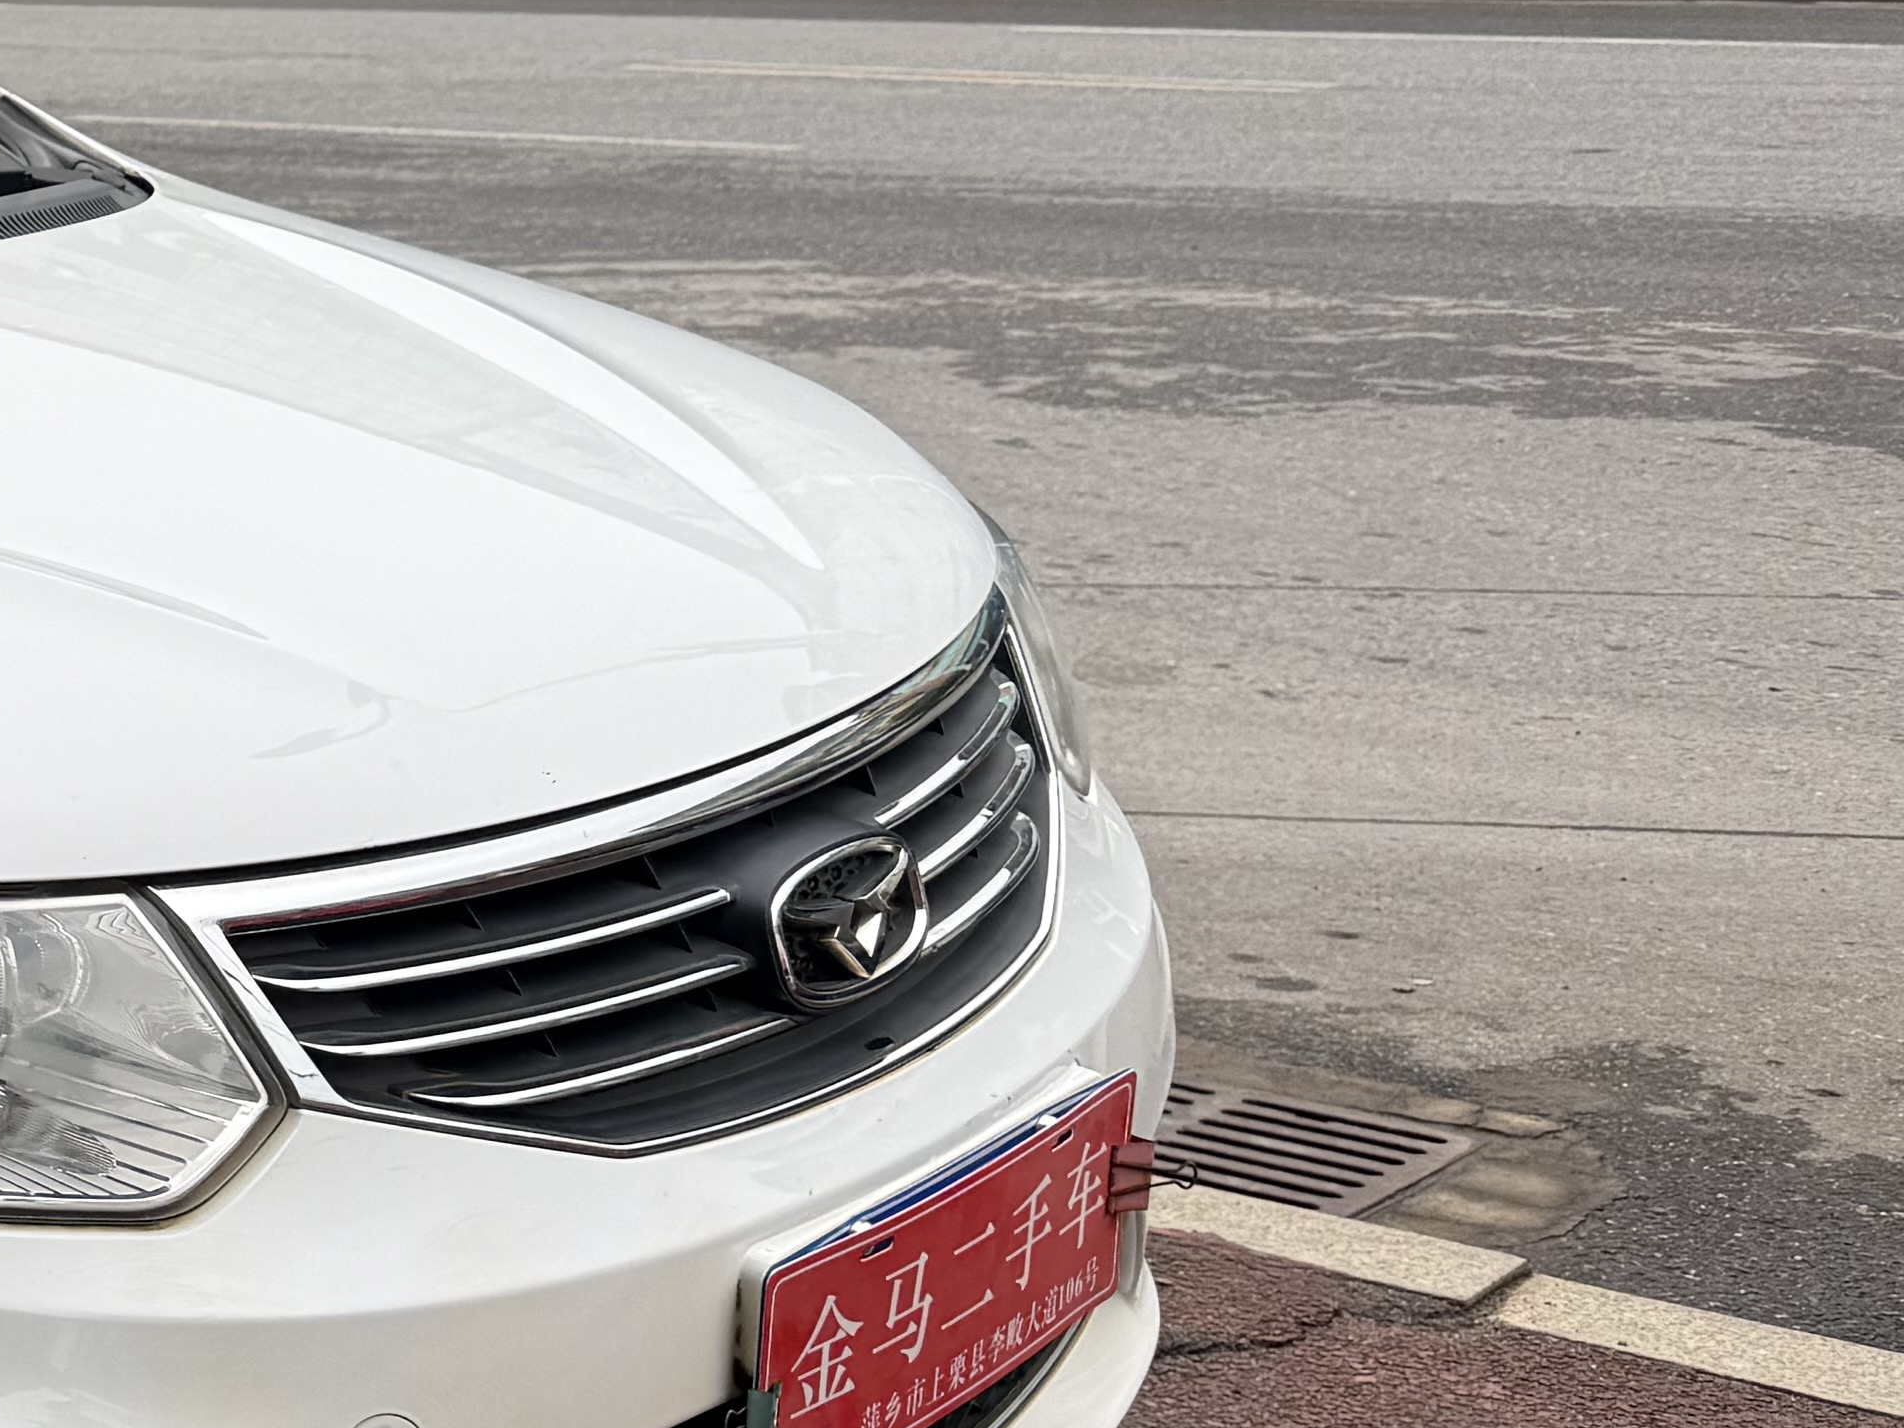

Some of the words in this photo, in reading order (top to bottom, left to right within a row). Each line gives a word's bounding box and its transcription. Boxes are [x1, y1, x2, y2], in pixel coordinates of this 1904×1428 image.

[790, 1140, 1111, 1420] 金马二手车
